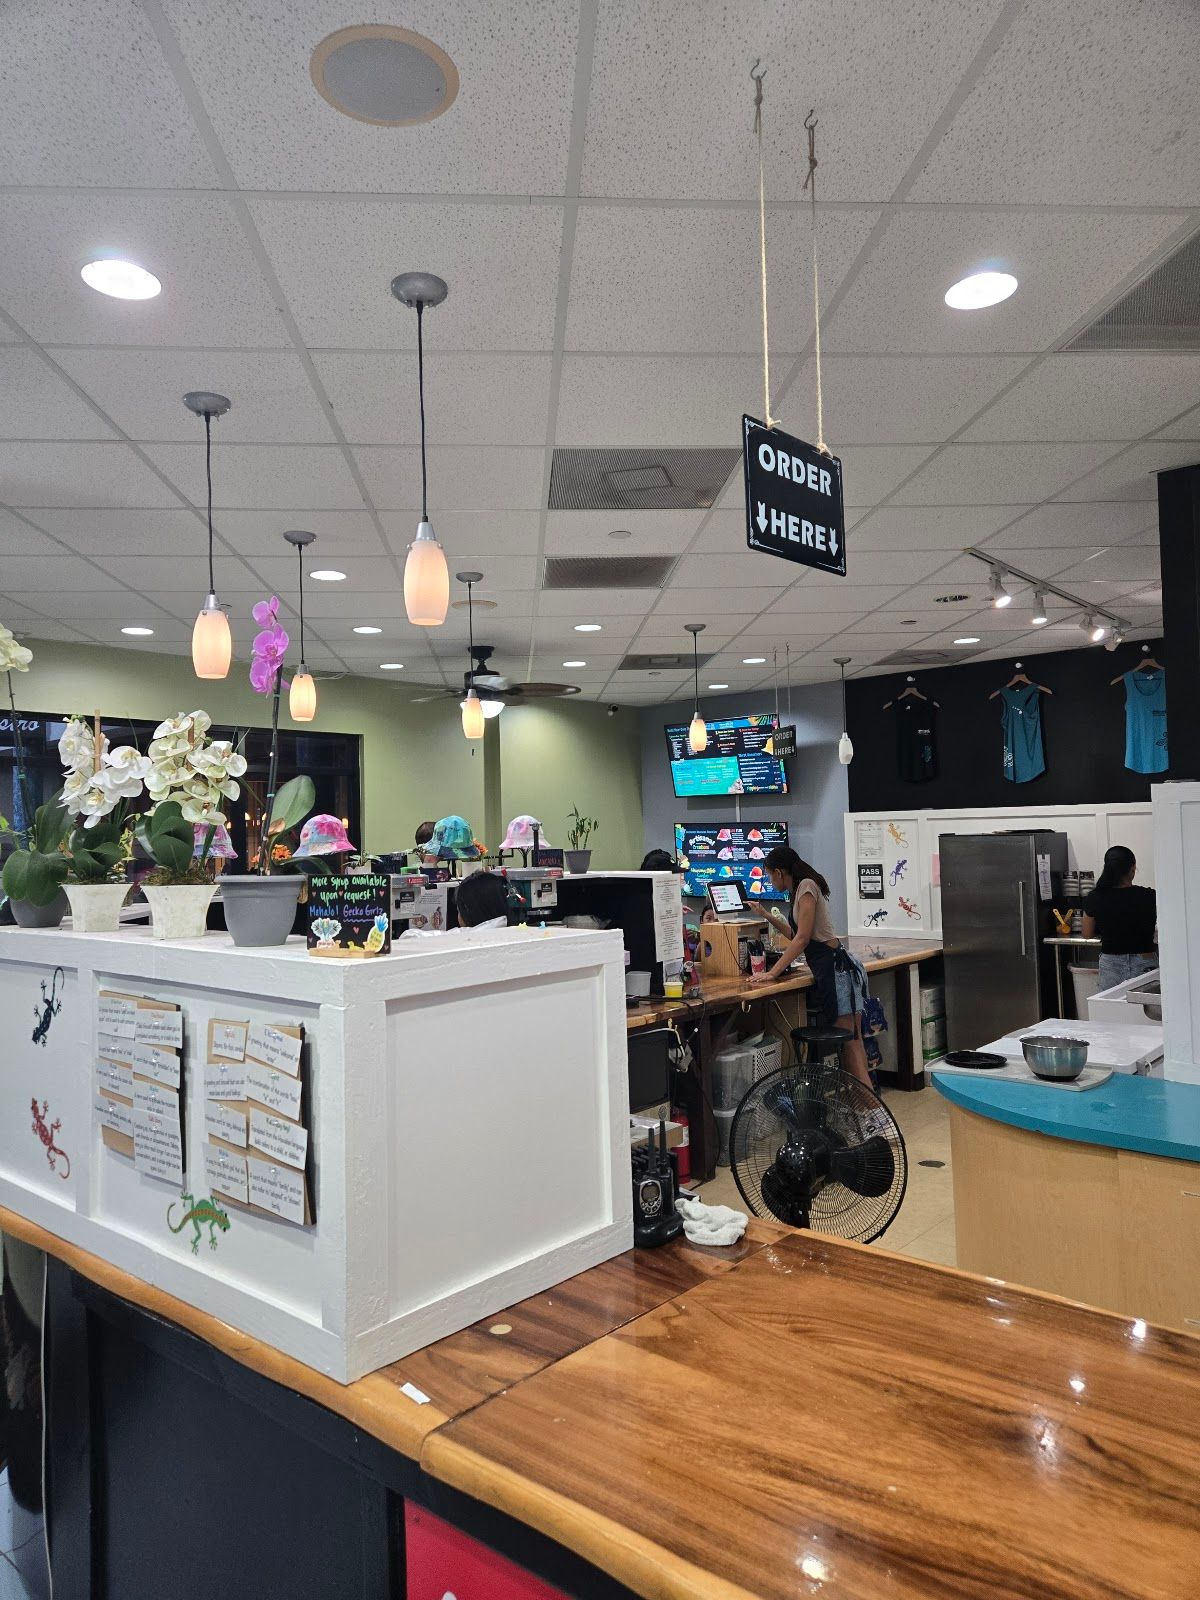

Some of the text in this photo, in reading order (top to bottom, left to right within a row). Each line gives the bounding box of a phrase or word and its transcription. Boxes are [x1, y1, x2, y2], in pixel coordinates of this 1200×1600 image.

[758, 443, 832, 497] ORDER
[770, 508, 827, 551] HERE
[777, 746, 792, 756] HERE
[311, 875, 387, 890] More syrup available
[320, 891, 338, 907] upon
[343, 904, 364, 917] Gecko
[364, 904, 384, 916] Girlz
